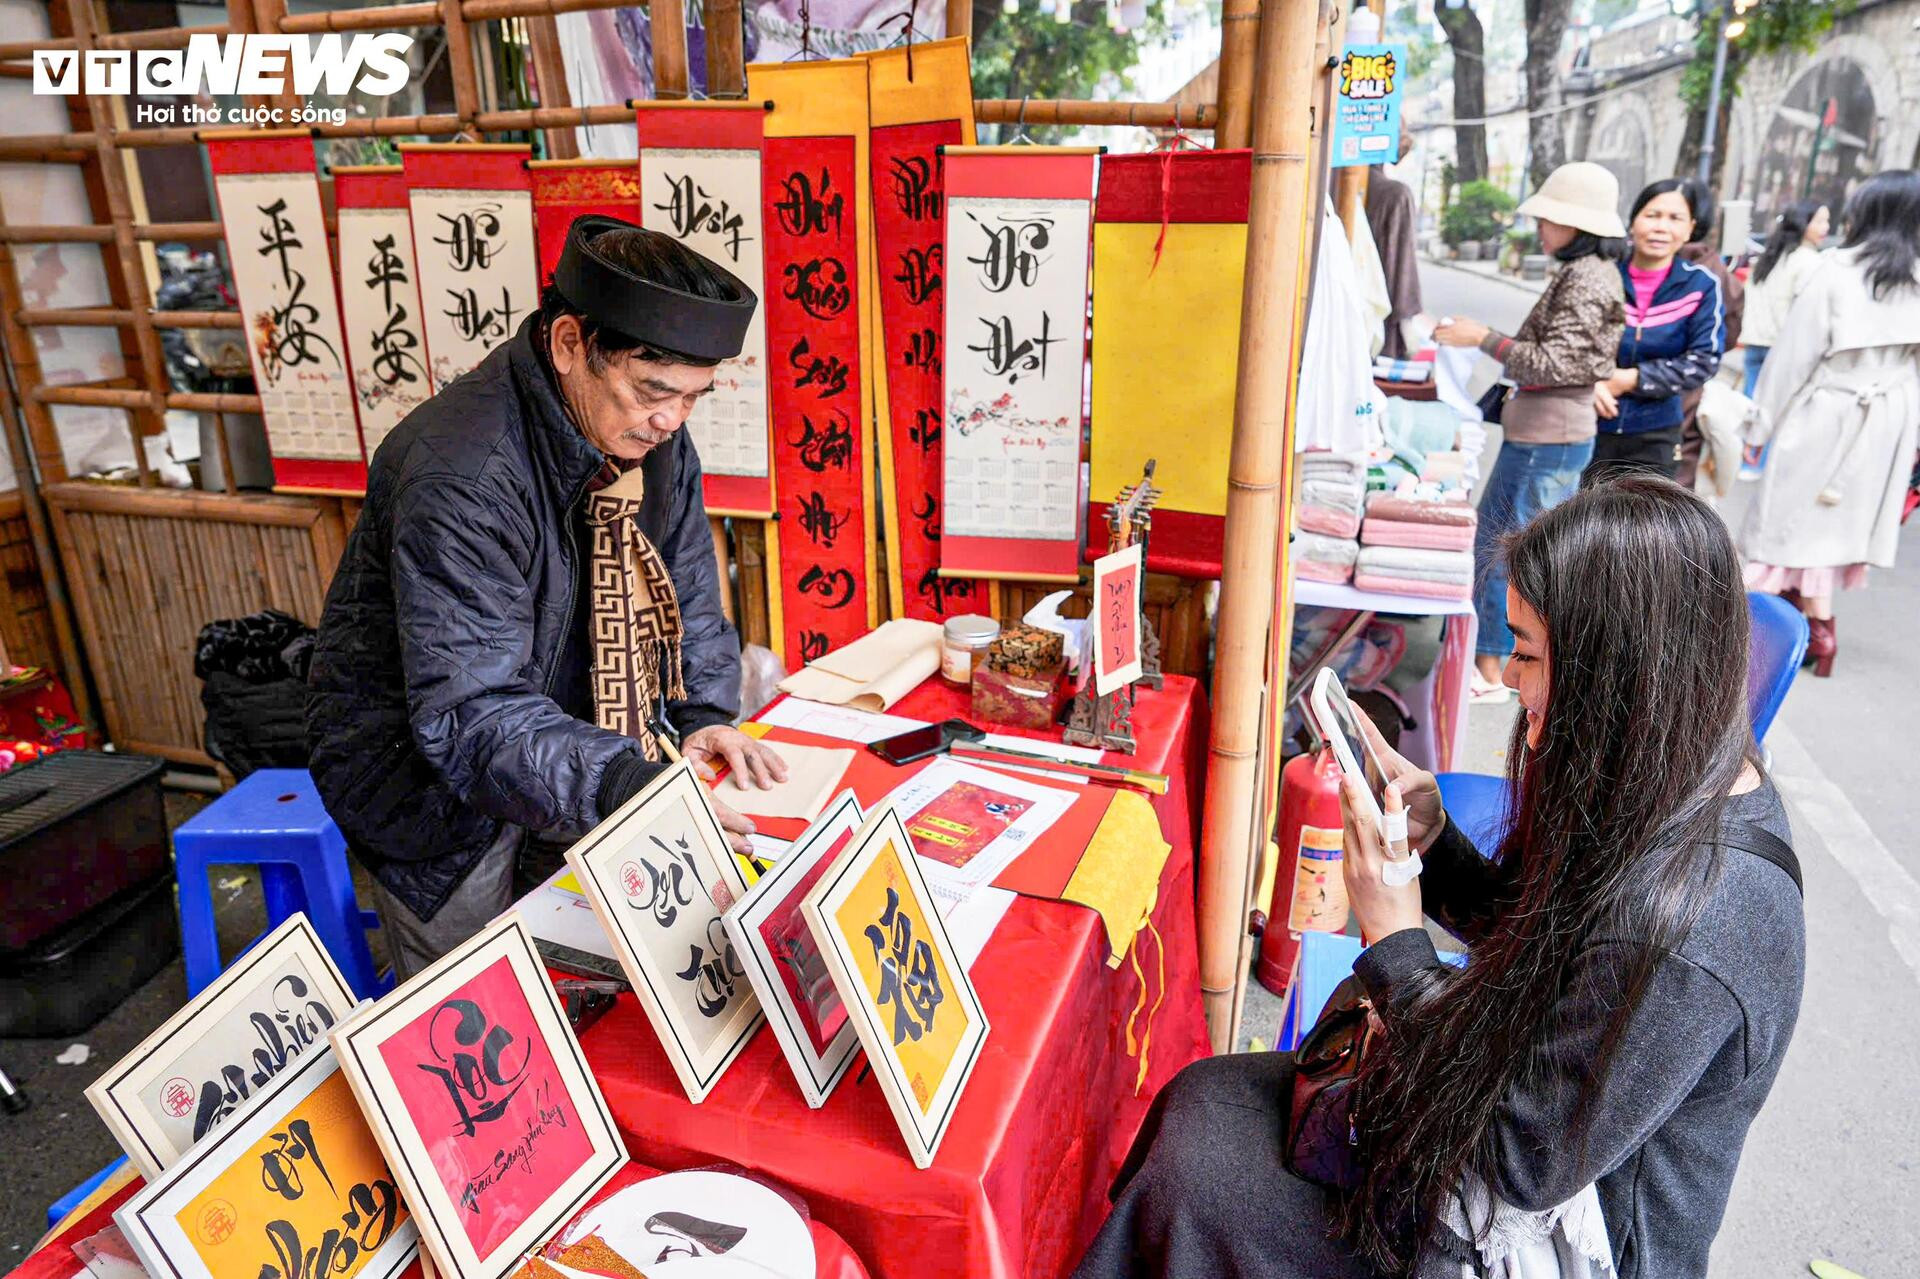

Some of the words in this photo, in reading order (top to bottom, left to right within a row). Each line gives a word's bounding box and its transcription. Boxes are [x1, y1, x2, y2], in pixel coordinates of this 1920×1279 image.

[1349, 79, 1386, 98] SALE
[1350, 56, 1387, 80] BIG
[864, 887, 945, 1047] 福
[416, 999, 532, 1138] Lộc
